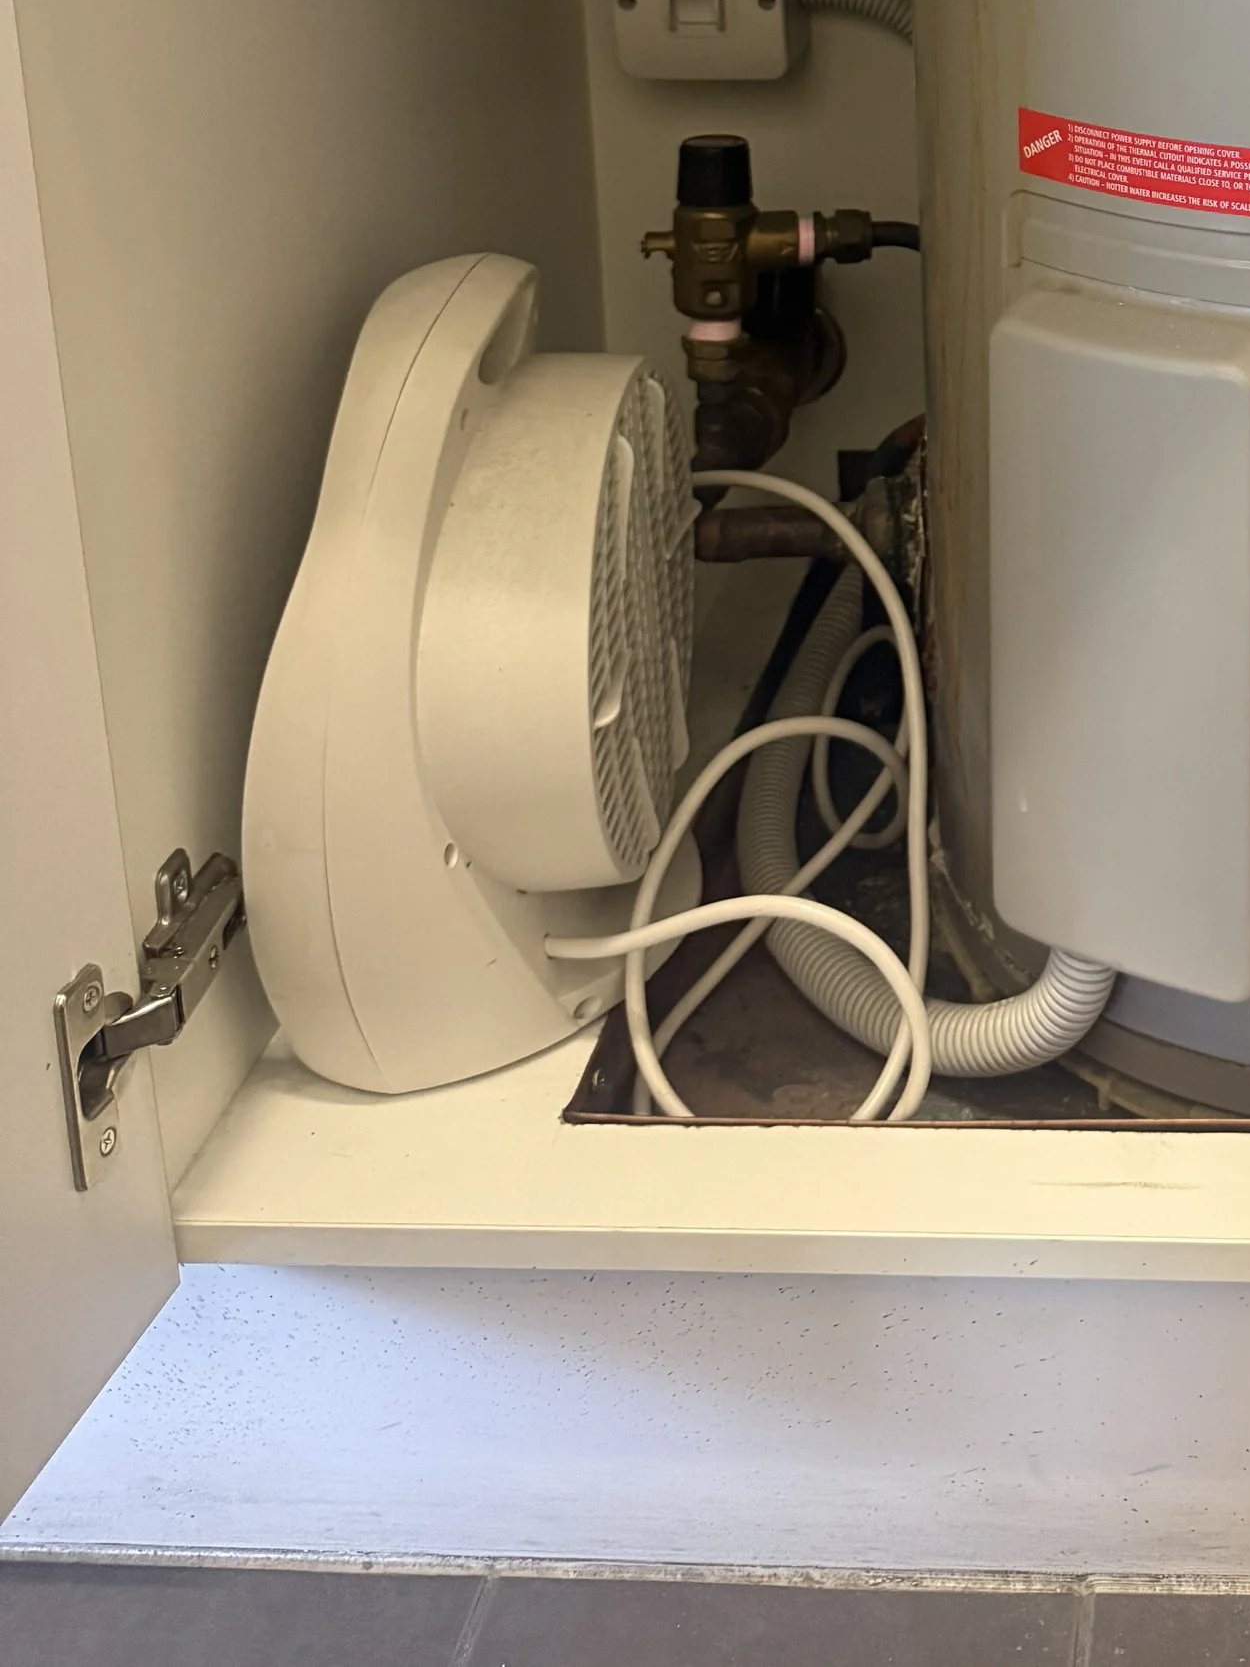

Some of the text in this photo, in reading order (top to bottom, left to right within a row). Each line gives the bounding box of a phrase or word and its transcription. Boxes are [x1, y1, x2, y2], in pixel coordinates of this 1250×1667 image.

[1023, 129, 1063, 159] DANGER
[1074, 125, 1110, 139] DISCONNECT
[1111, 133, 1132, 144] POWER
[1134, 136, 1156, 149] SUPPLY
[1158, 141, 1182, 152] BEFORE
[1184, 144, 1215, 156] OPENING
[1217, 149, 1241, 160] COVER.
[1074, 135, 1106, 149] OPERATION
[1107, 142, 1115, 150] OF
[1117, 144, 1127, 154] THE
[1129, 146, 1158, 159] THERMAL
[1160, 152, 1185, 163] CUTOUT
[1187, 156, 1221, 168] INDICATES
[1223, 159, 1229, 169] A
[1074, 144, 1104, 159] SITUATION
[1118, 154, 1131, 164] THIS
[1132, 157, 1152, 168] EVENT
[1154, 161, 1170, 171] CALL
[1177, 164, 1212, 177] QUALIFIED
[1214, 169, 1242, 180] SERVICE
[1074, 164, 1129, 183] ELECTRICAL COVER.
[1075, 154, 1084, 163] DO
[1085, 157, 1097, 167] NOT
[1098, 159, 1116, 171] PLACE
[1117, 163, 1159, 180] COMBUSTIBLE
[1160, 170, 1197, 185] MATERIALS
[1198, 177, 1220, 188] CLOSE
[1233, 181, 1244, 191] OR
[1075, 175, 1101, 188] CAUTION
[1106, 182, 1129, 194] HOTTER
[1129, 186, 1151, 198] WATER
[1151, 190, 1187, 204] INCREASES
[1188, 196, 1201, 206] THE
[1202, 198, 1219, 208] RISK
[1220, 201, 1230, 210] OF
